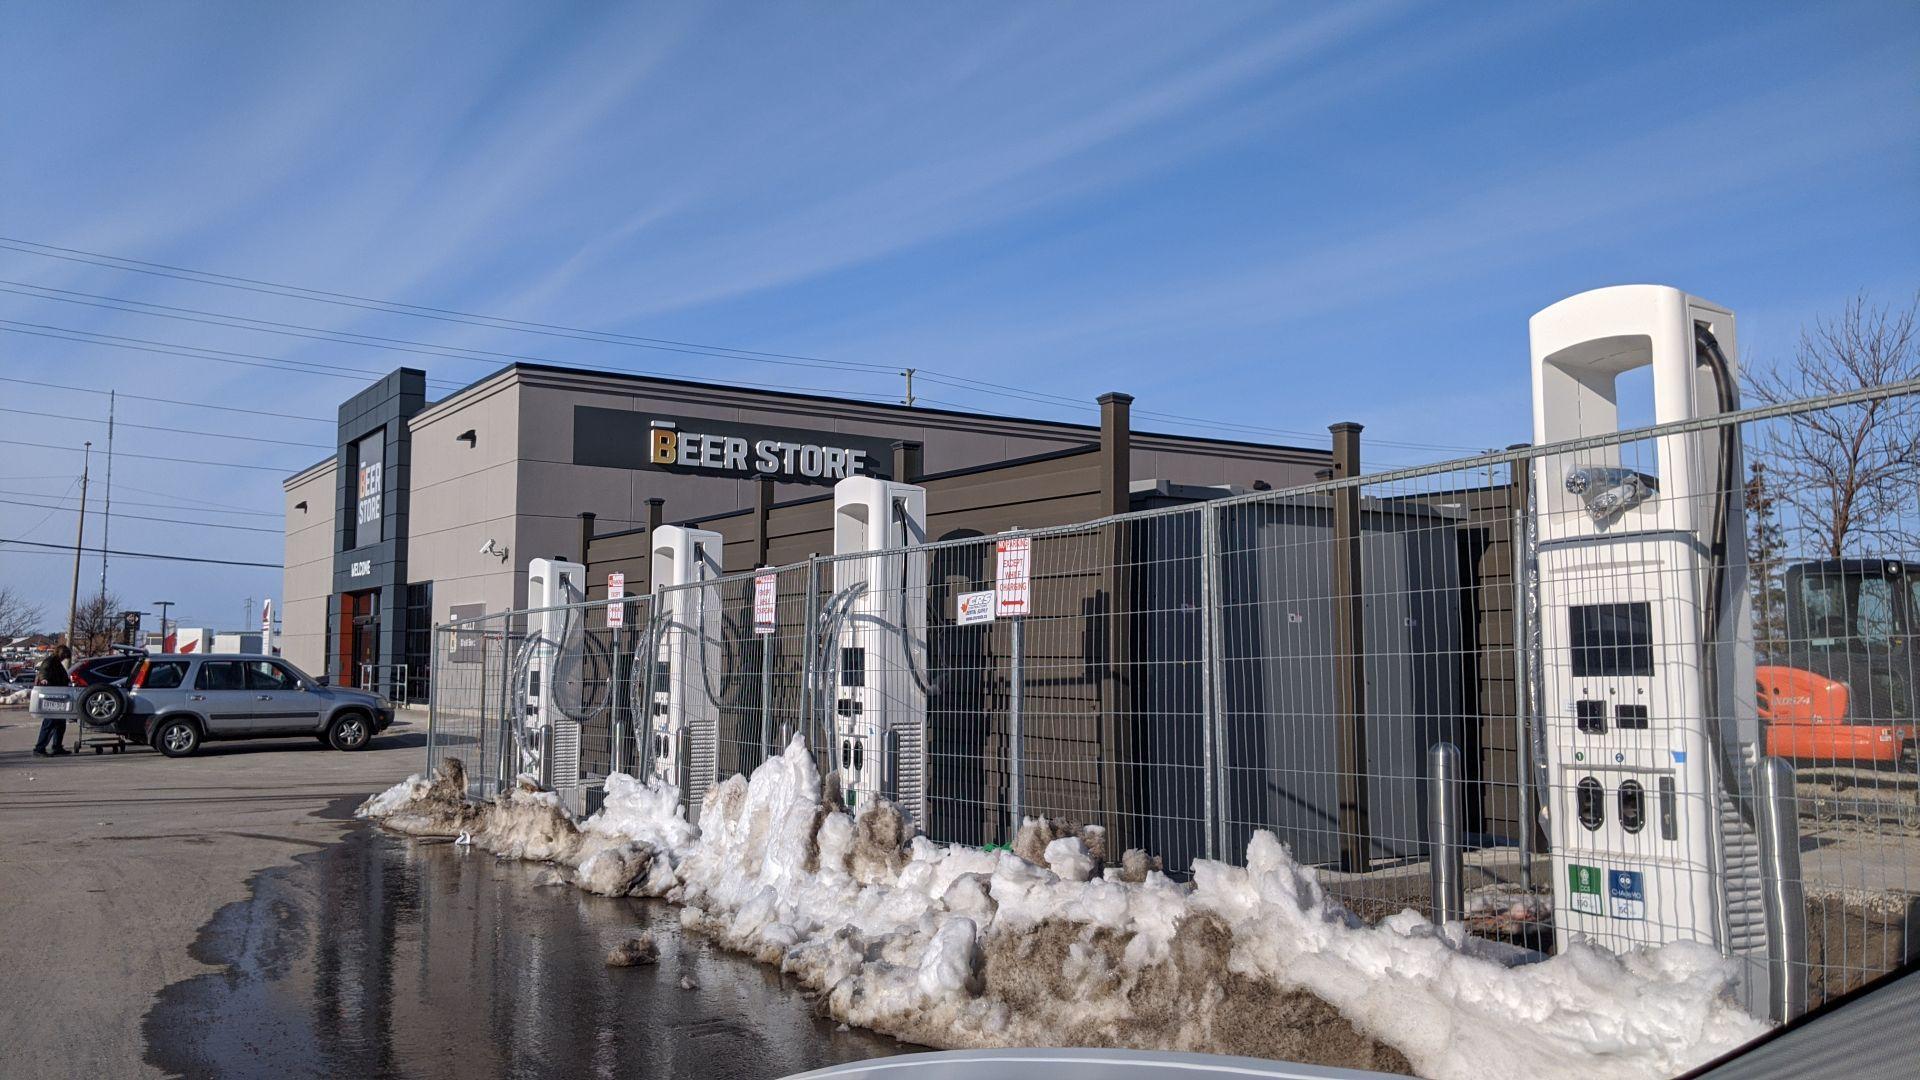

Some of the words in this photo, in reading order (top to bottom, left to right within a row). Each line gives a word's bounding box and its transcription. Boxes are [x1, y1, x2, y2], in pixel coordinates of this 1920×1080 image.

[650, 427, 748, 471] BEER
[755, 440, 867, 479] STORE
[359, 462, 381, 499] BEER
[358, 495, 380, 525] STORE
[351, 560, 371, 577] WELCOME
[1003, 558, 1024, 568] EXCEPT
[1000, 582, 1026, 591] CHARGING
